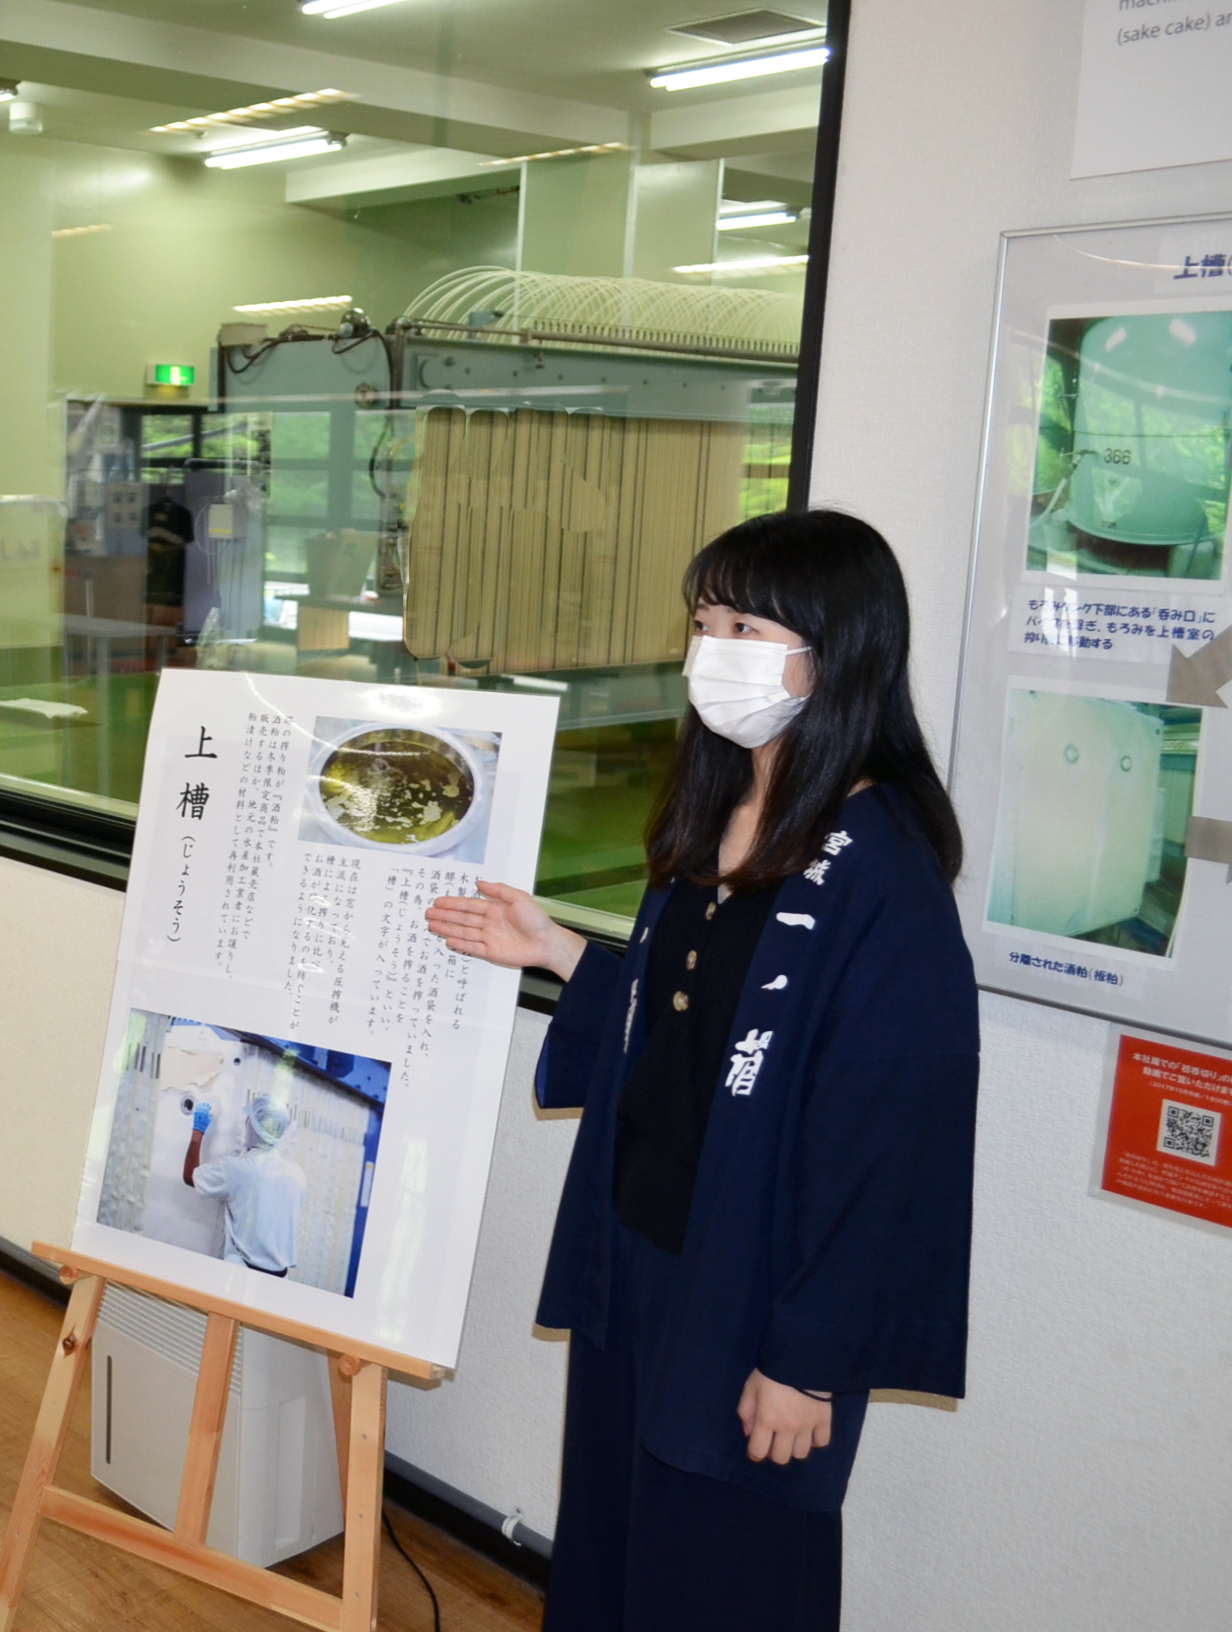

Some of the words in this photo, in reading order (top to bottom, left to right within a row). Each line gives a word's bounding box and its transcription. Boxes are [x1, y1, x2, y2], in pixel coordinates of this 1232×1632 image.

[1117, 23, 1161, 46] (sake
[1164, 12, 1211, 36] cake)
[1104, 447, 1132, 465] 366
[803, 830, 853, 886] 宮城
